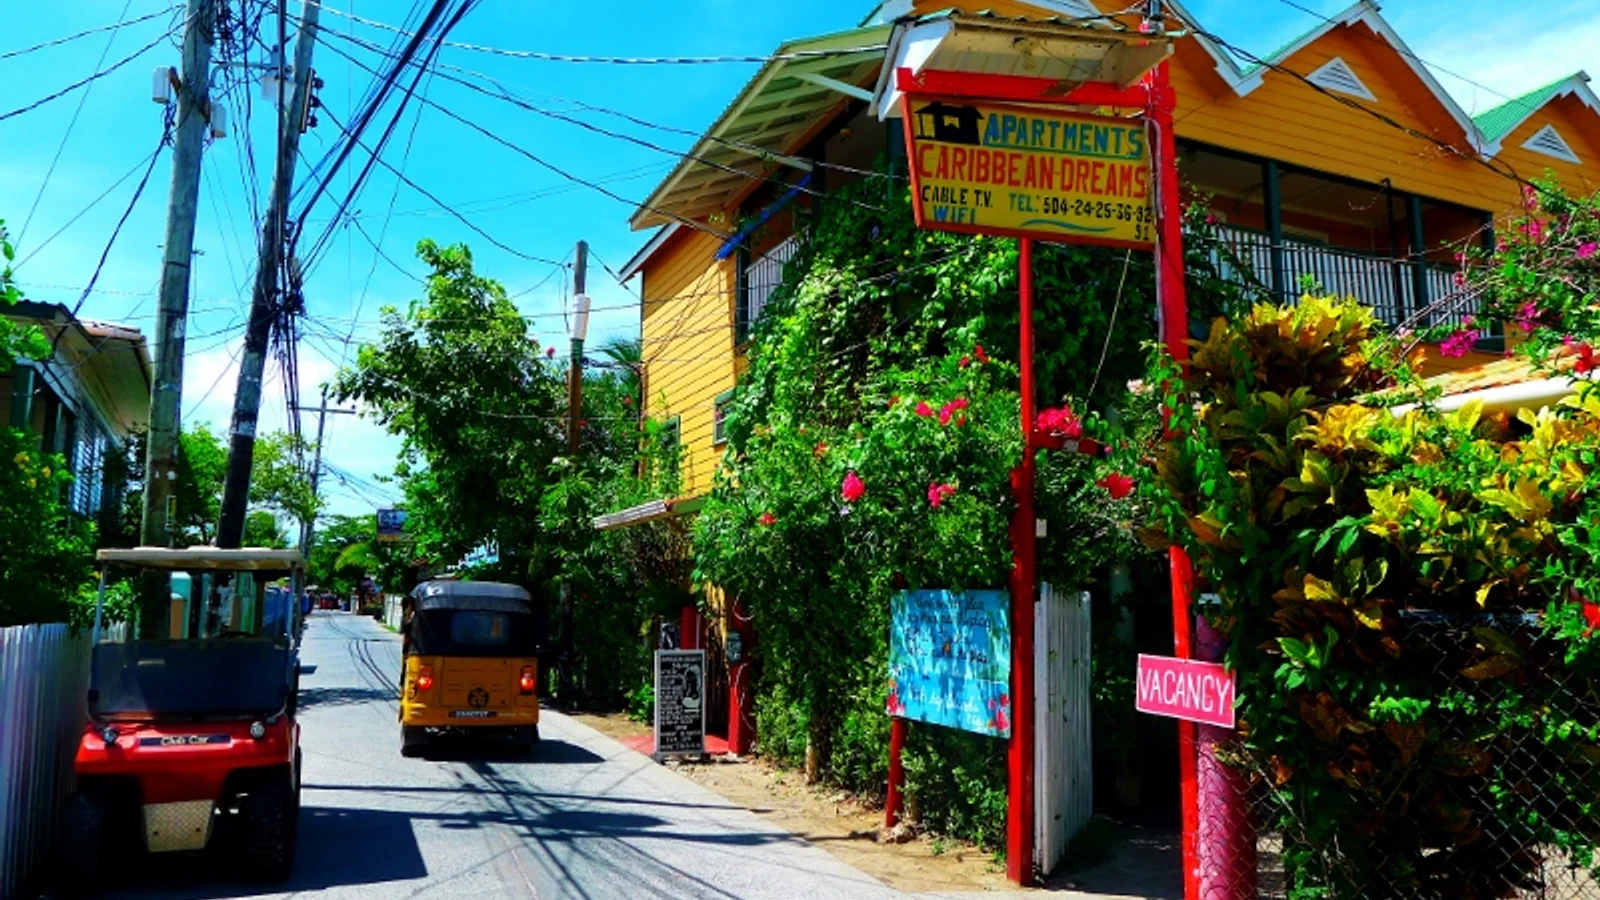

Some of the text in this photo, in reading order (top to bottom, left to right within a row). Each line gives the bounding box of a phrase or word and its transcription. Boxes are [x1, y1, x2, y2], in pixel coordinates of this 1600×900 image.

[982, 112, 1145, 160] APARTMENTS
[922, 185, 968, 206] CABLE
[933, 205, 977, 225] WIFI
[1138, 668, 1231, 716] VACANCY
